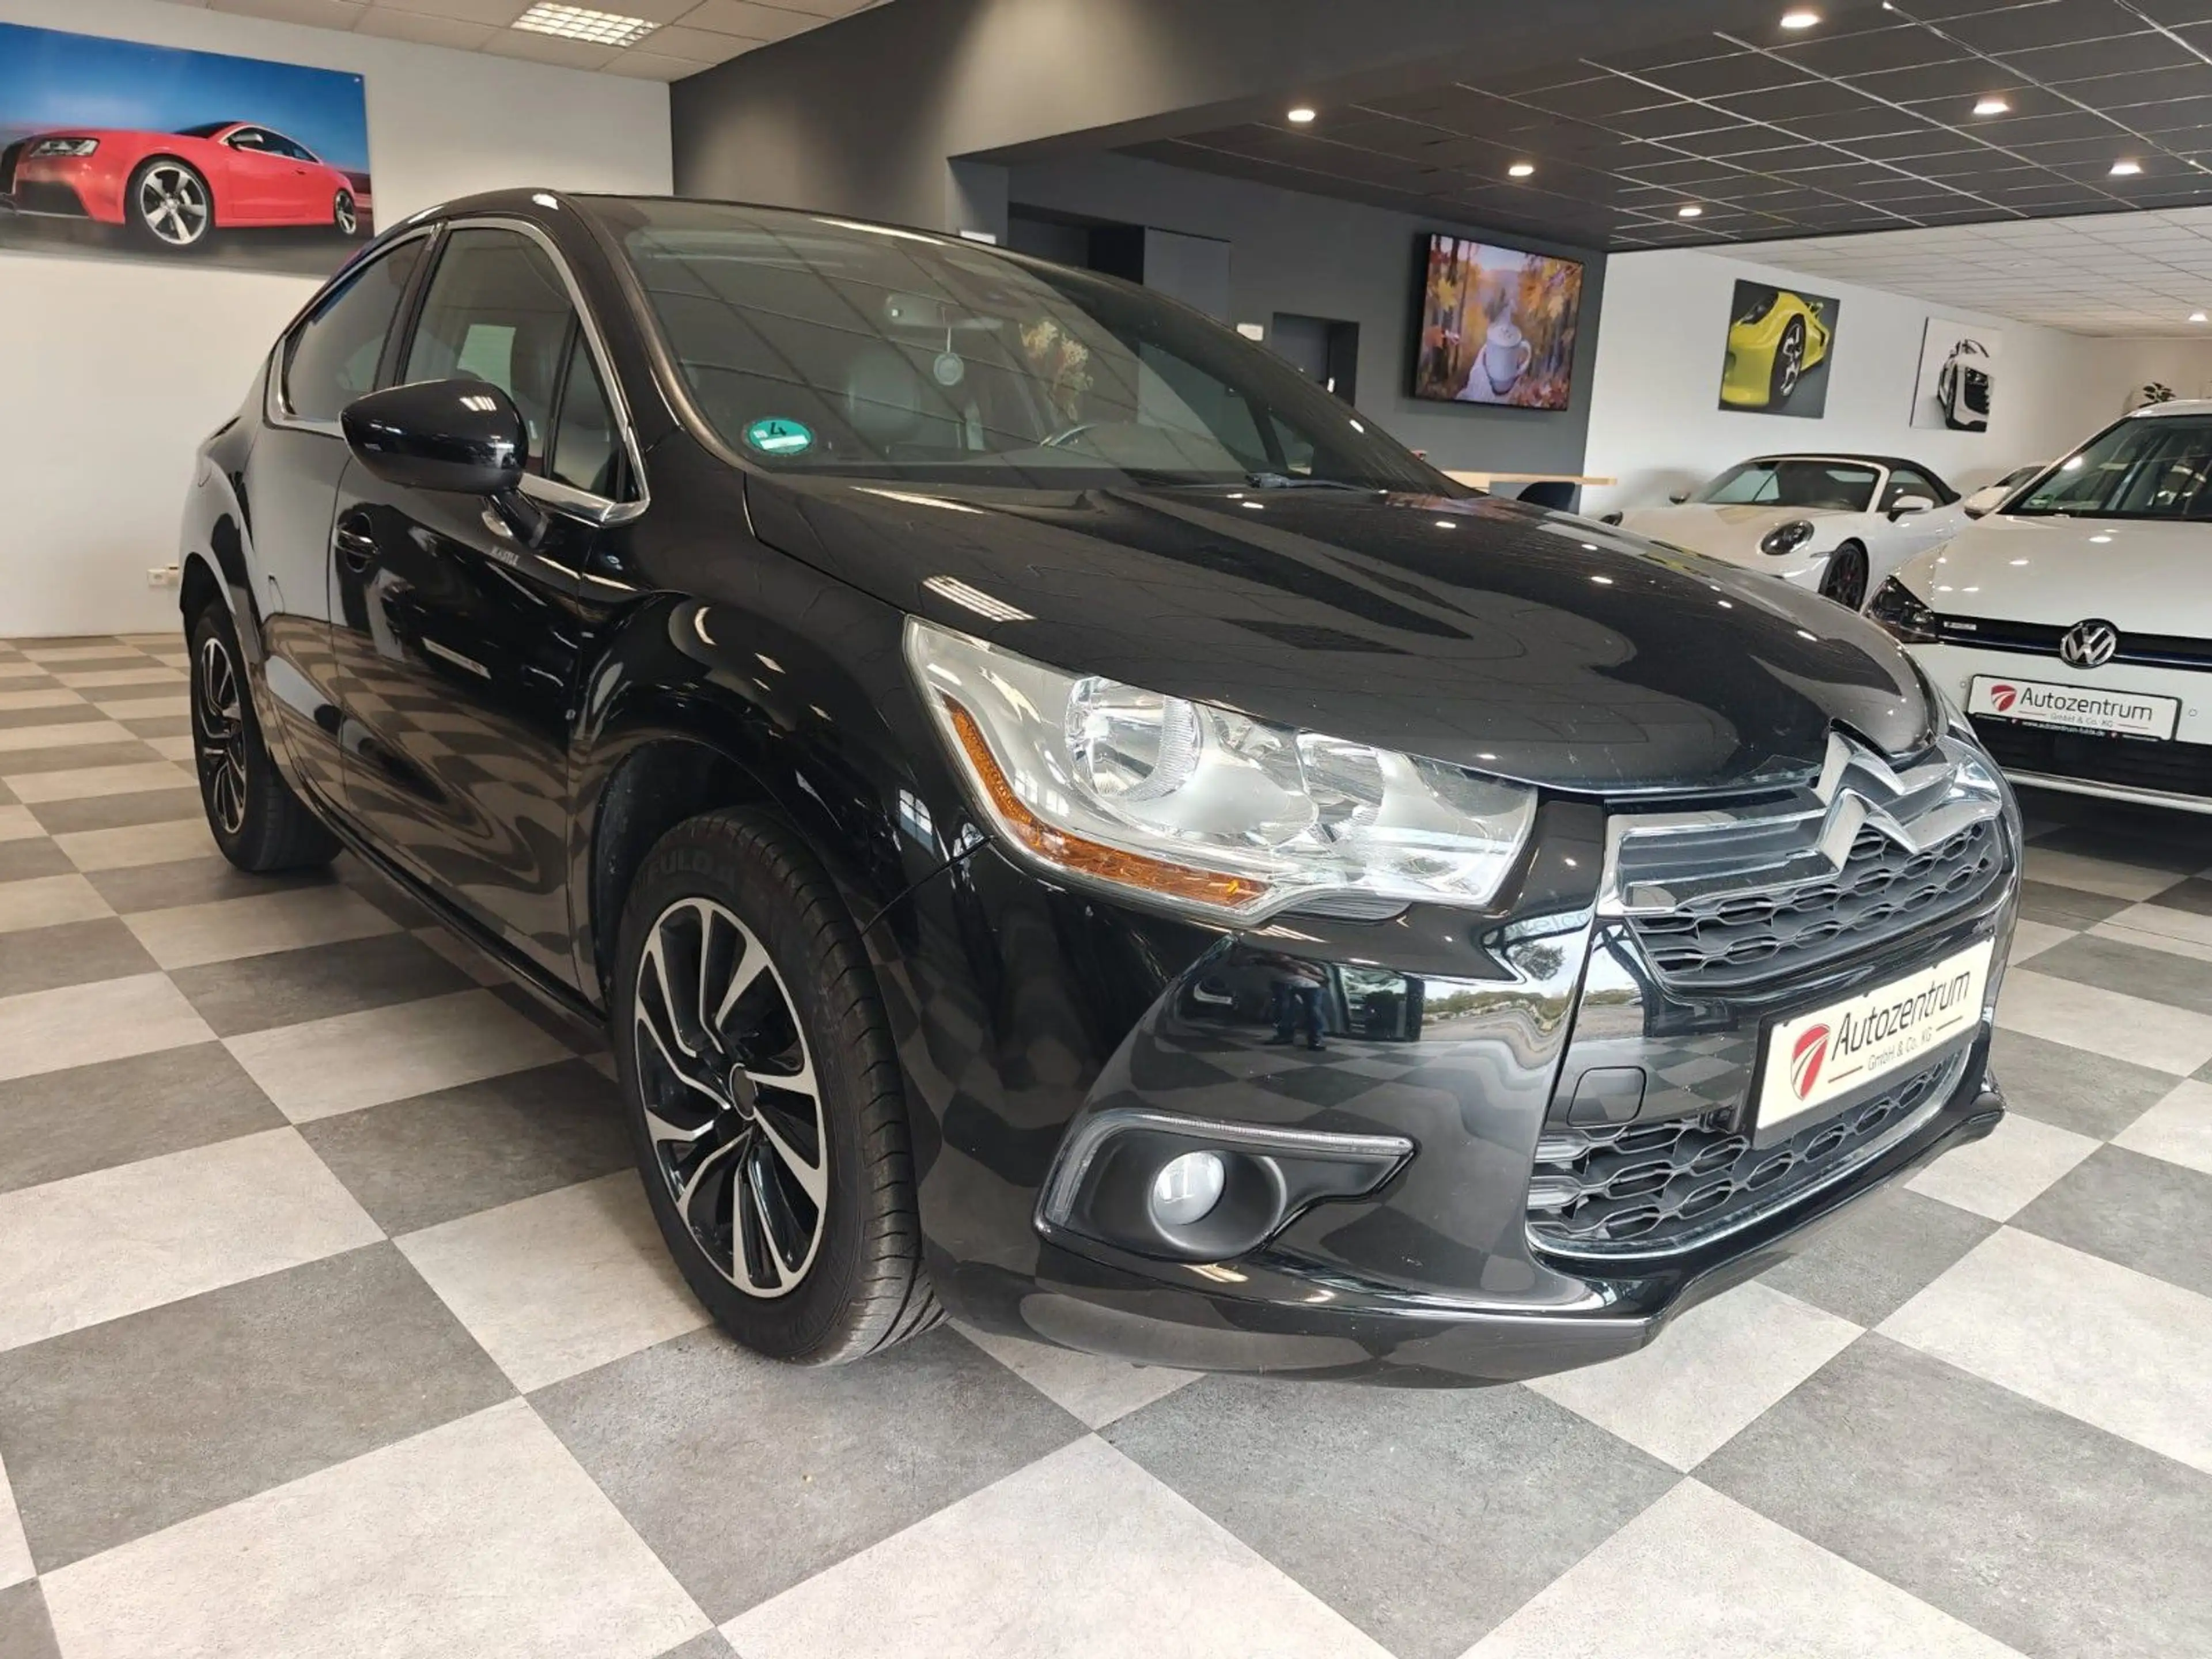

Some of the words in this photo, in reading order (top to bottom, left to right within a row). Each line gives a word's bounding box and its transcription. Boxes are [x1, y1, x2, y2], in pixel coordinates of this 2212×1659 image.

[2019, 687, 2153, 721] Autozentrum
[1831, 971, 1971, 1062] Autozentrum
[1868, 1044, 1895, 1071] GmbH
[1897, 1040, 1903, 1057] &
[1921, 1027, 1933, 1047] KG
